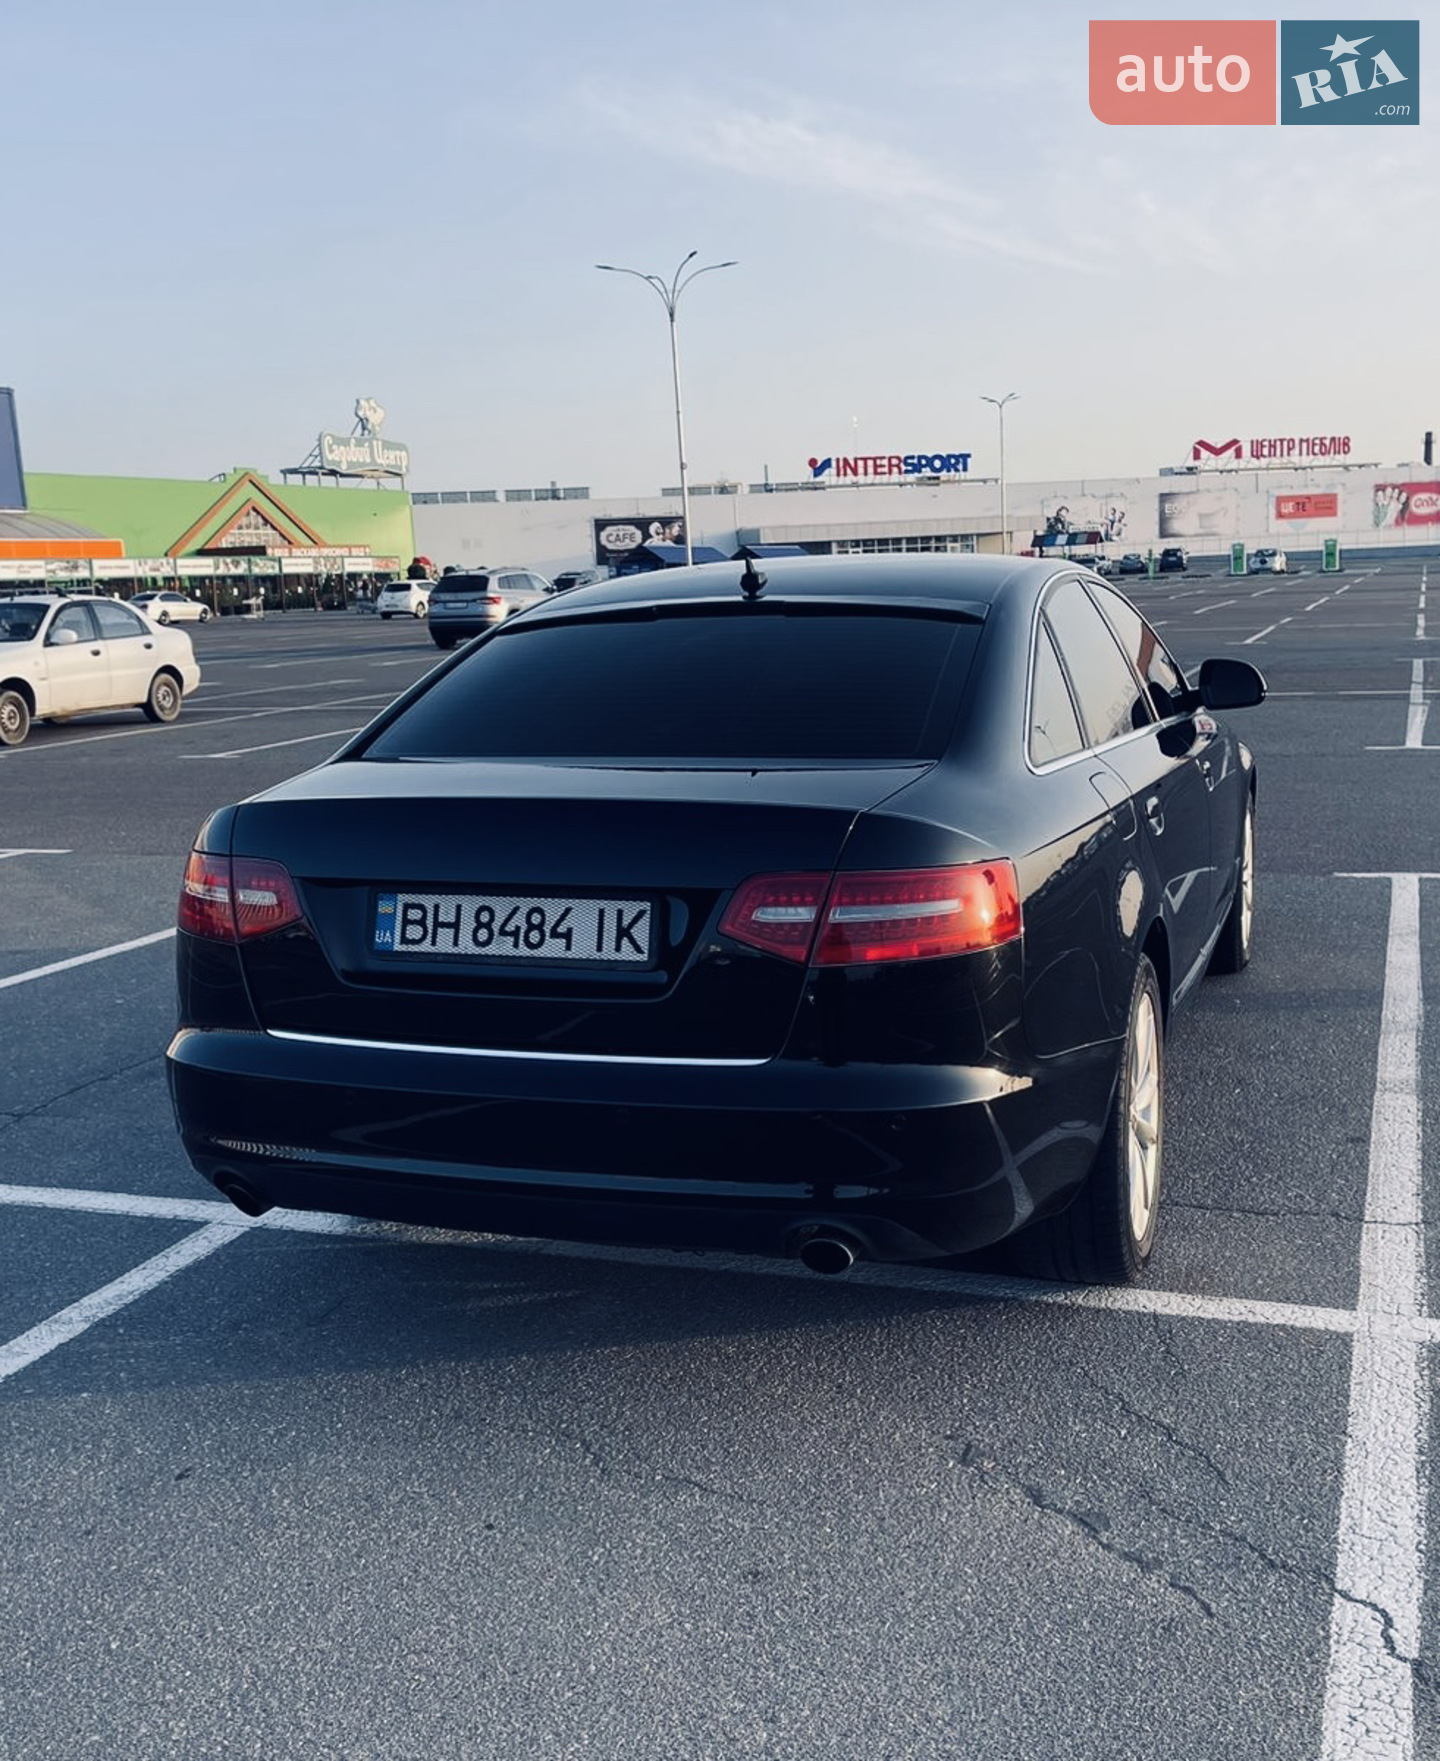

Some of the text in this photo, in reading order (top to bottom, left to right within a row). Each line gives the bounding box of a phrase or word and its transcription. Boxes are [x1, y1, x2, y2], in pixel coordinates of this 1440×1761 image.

[372, 440, 408, 474] Центр
[1250, 438, 1296, 460] ЦЕНТР
[1299, 436, 1351, 457] МЕБЛІВ
[836, 453, 972, 477] INTERSPORT
[605, 532, 636, 544] CAFE
[375, 929, 393, 944] UA
[399, 902, 647, 955] BH 8484 IK
